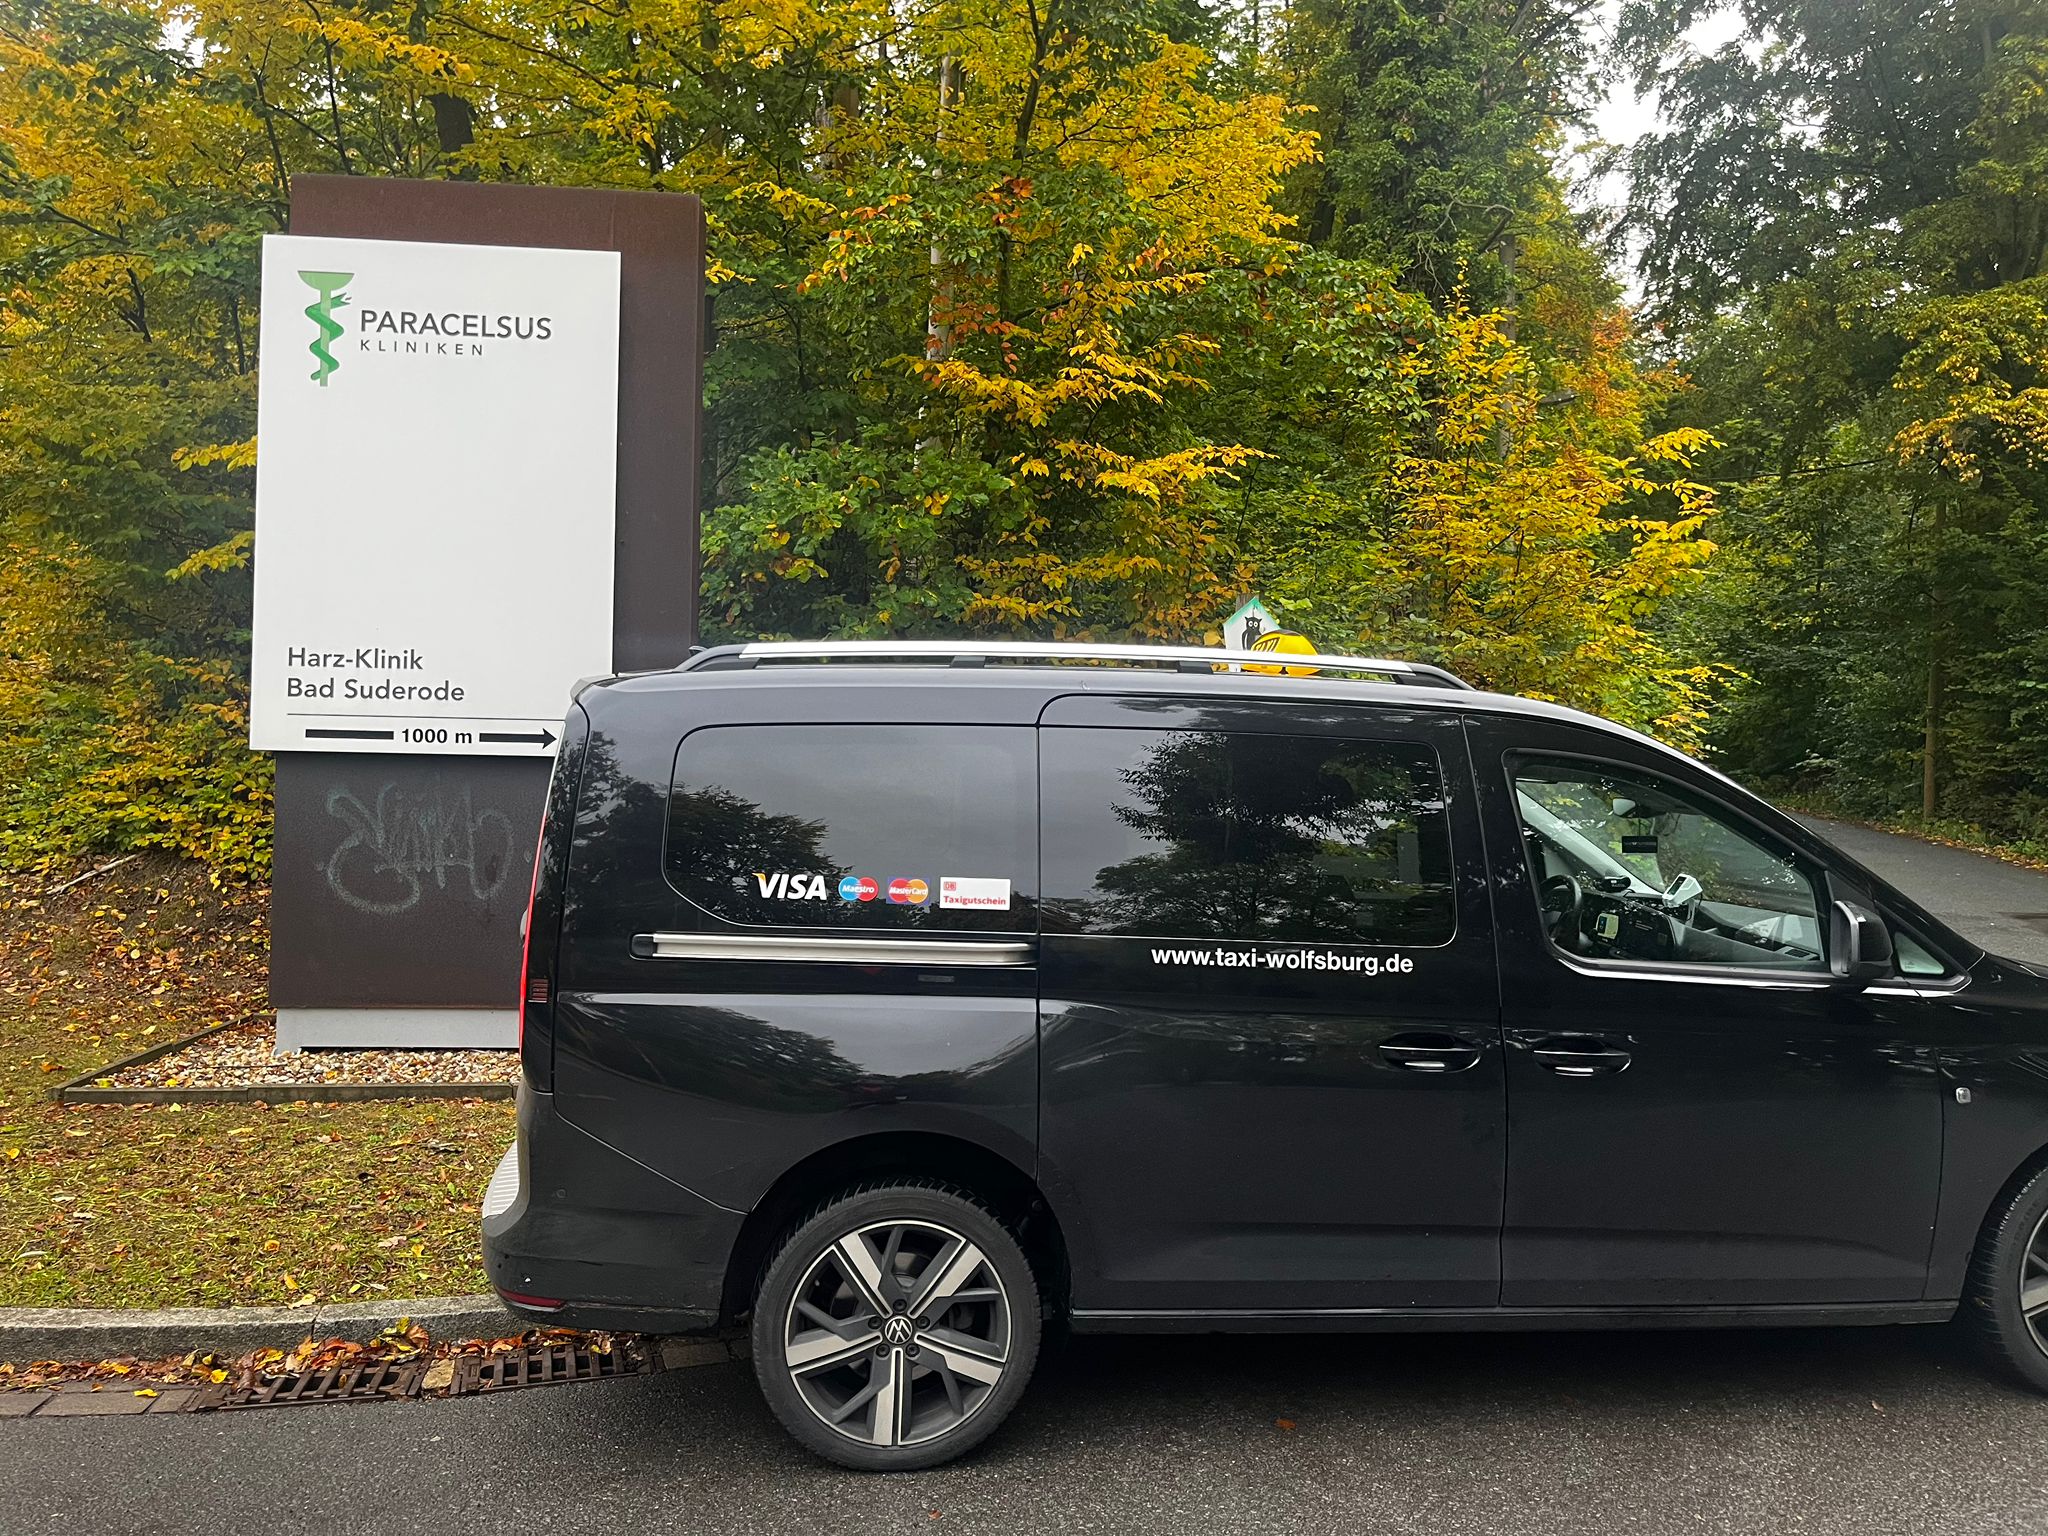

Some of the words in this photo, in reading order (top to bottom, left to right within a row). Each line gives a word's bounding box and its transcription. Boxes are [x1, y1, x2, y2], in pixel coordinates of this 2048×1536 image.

[360, 309, 552, 340] PARACELSUS
[360, 339, 483, 356] KLINIKEN
[287, 647, 424, 670] Harz-Klinik
[287, 677, 334, 699] Bad
[344, 678, 465, 701] Suderode
[401, 728, 448, 744] 1000
[455, 732, 473, 744] m
[752, 872, 827, 900] VISA
[842, 884, 875, 894] Maestro
[889, 886, 929, 897] MasterCard
[943, 895, 1007, 907] Taxigutschein
[1151, 947, 1414, 976] www.taxi-wolfsburg.de
